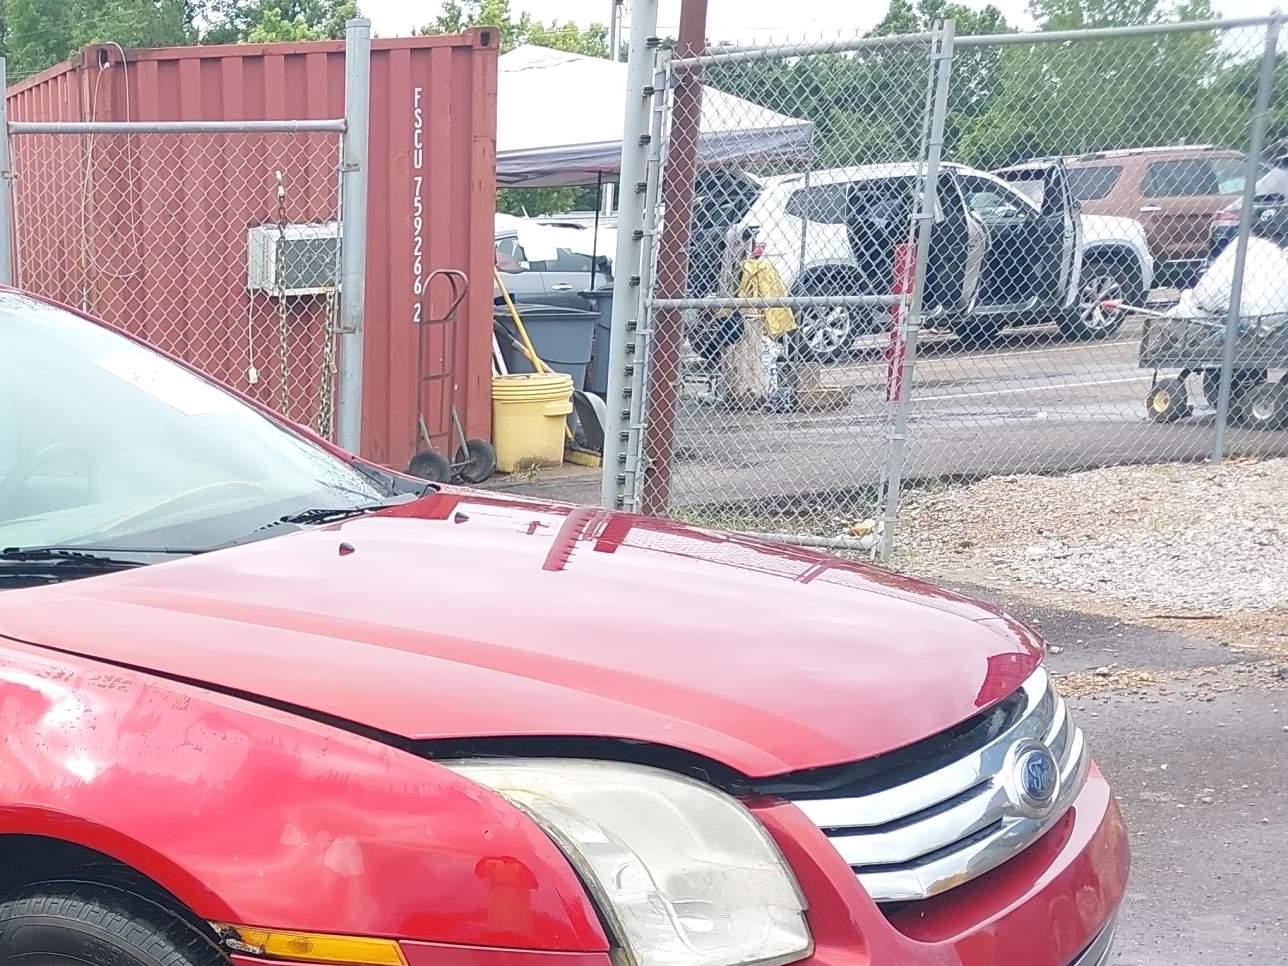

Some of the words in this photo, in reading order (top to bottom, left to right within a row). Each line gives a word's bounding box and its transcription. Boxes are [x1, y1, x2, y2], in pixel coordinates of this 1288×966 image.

[413, 87, 423, 169] FSCU
[413, 176, 423, 295] 759266
[413, 302, 422, 323] 2
